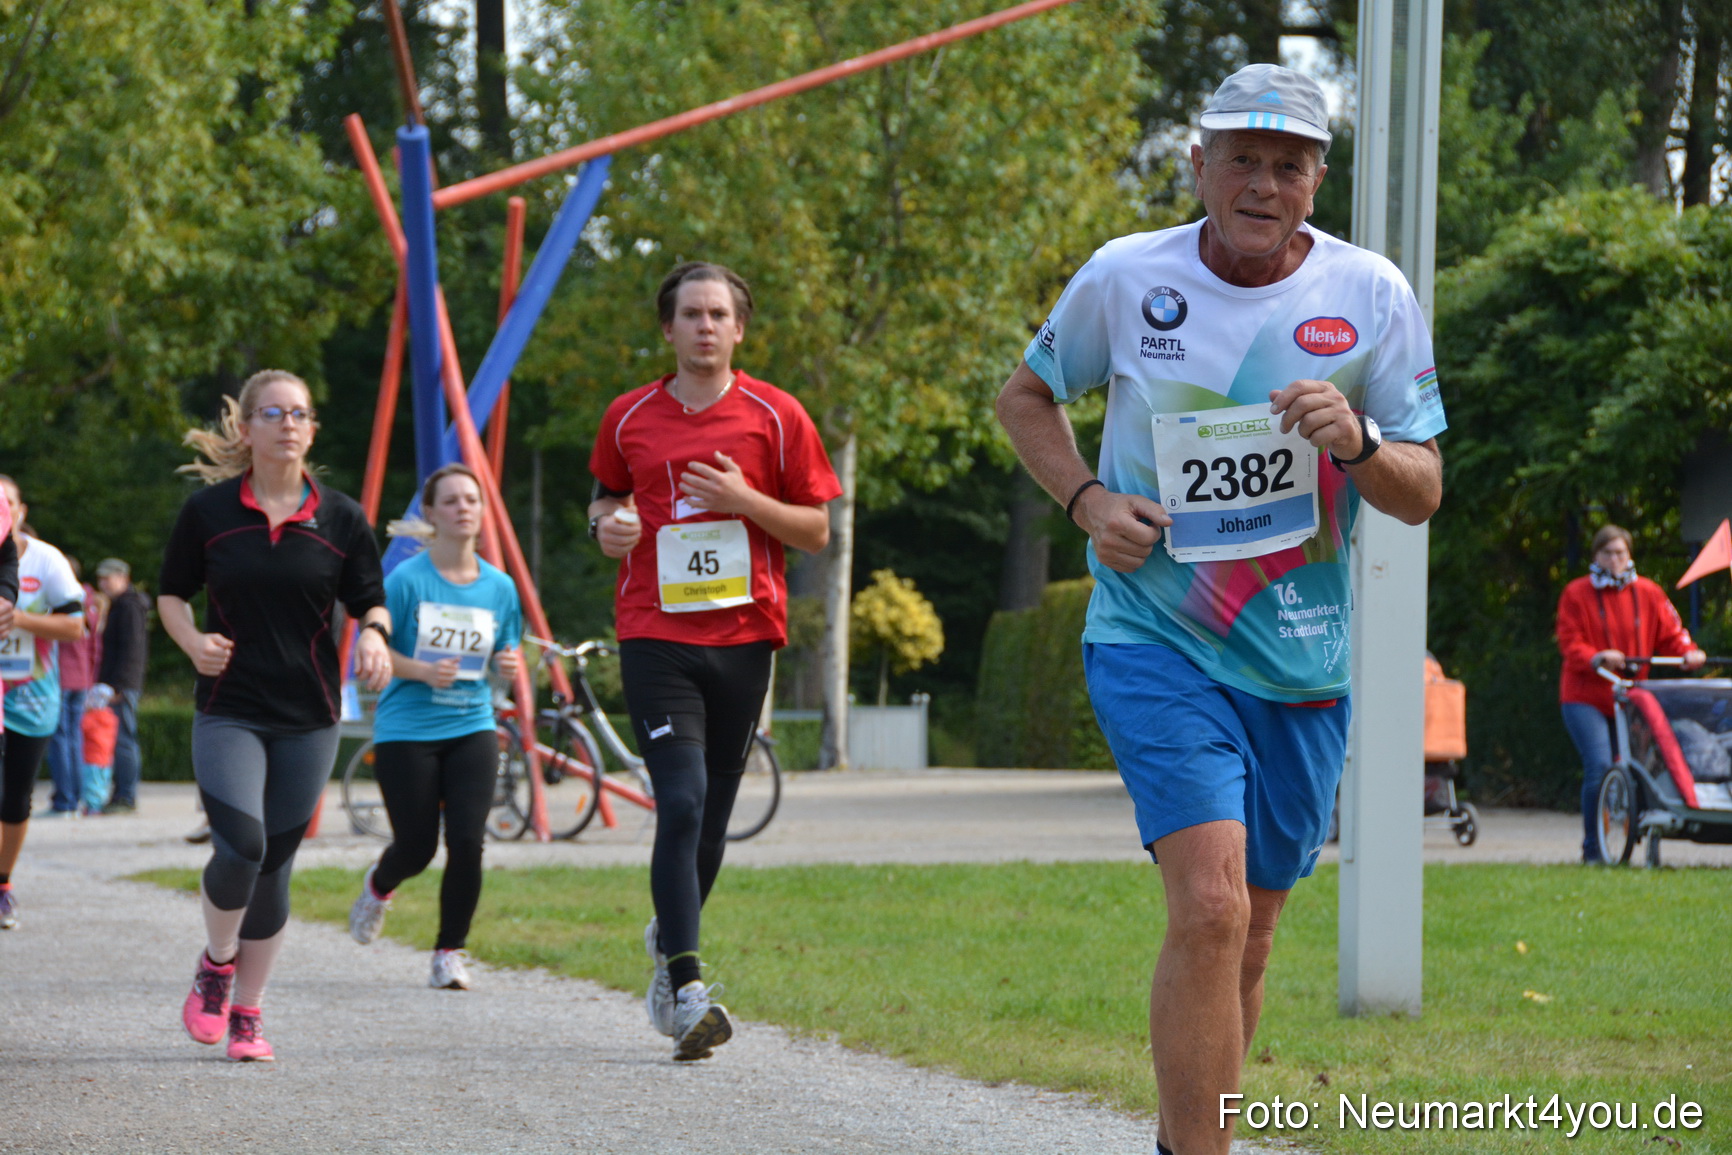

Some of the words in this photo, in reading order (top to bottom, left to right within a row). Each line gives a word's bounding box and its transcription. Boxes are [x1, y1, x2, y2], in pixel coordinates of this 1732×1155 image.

[1146, 287, 1185, 304] BMW
[1140, 336, 1186, 352] PARTL
[1303, 326, 1351, 346] Hervis
[1139, 349, 1185, 361] Neumarkt
[1214, 418, 1271, 436] BOCK
[1182, 448, 1295, 503] 2382
[1170, 498, 1177, 507] D
[1216, 513, 1272, 534] Johann
[687, 549, 720, 576] 45
[683, 583, 727, 597] Christoph
[1274, 582, 1303, 606] 16.
[1278, 605, 1339, 621] Neumarkter
[1279, 621, 1328, 638] Stadtlauf
[430, 626, 482, 652] 2712
